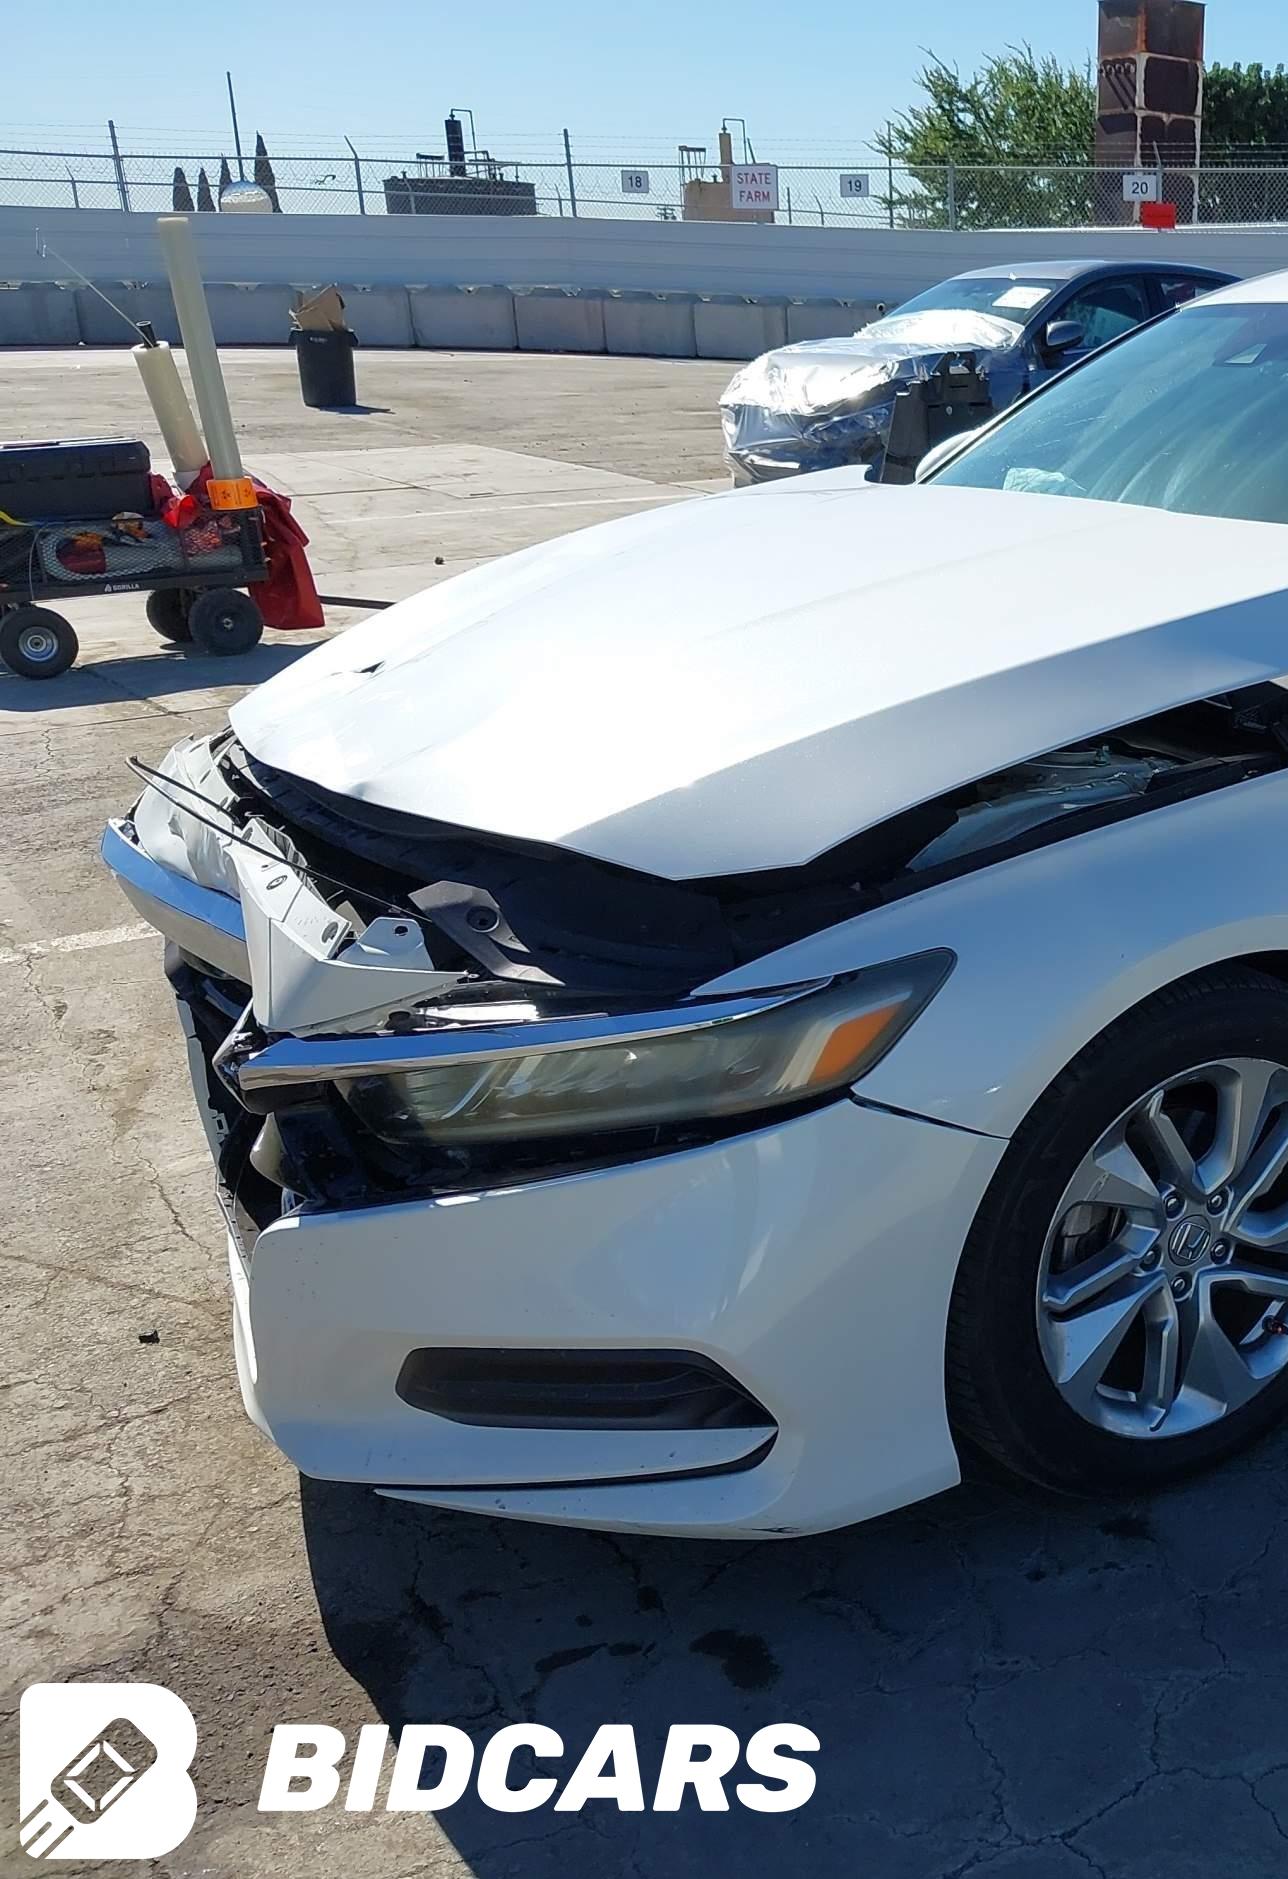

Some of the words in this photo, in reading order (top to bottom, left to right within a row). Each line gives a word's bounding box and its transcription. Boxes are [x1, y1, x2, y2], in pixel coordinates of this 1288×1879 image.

[627, 175, 643, 188] 18
[736, 172, 772, 185] STATE
[847, 179, 863, 192] 19
[1131, 181, 1149, 195] 20
[738, 190, 771, 202] FARM
